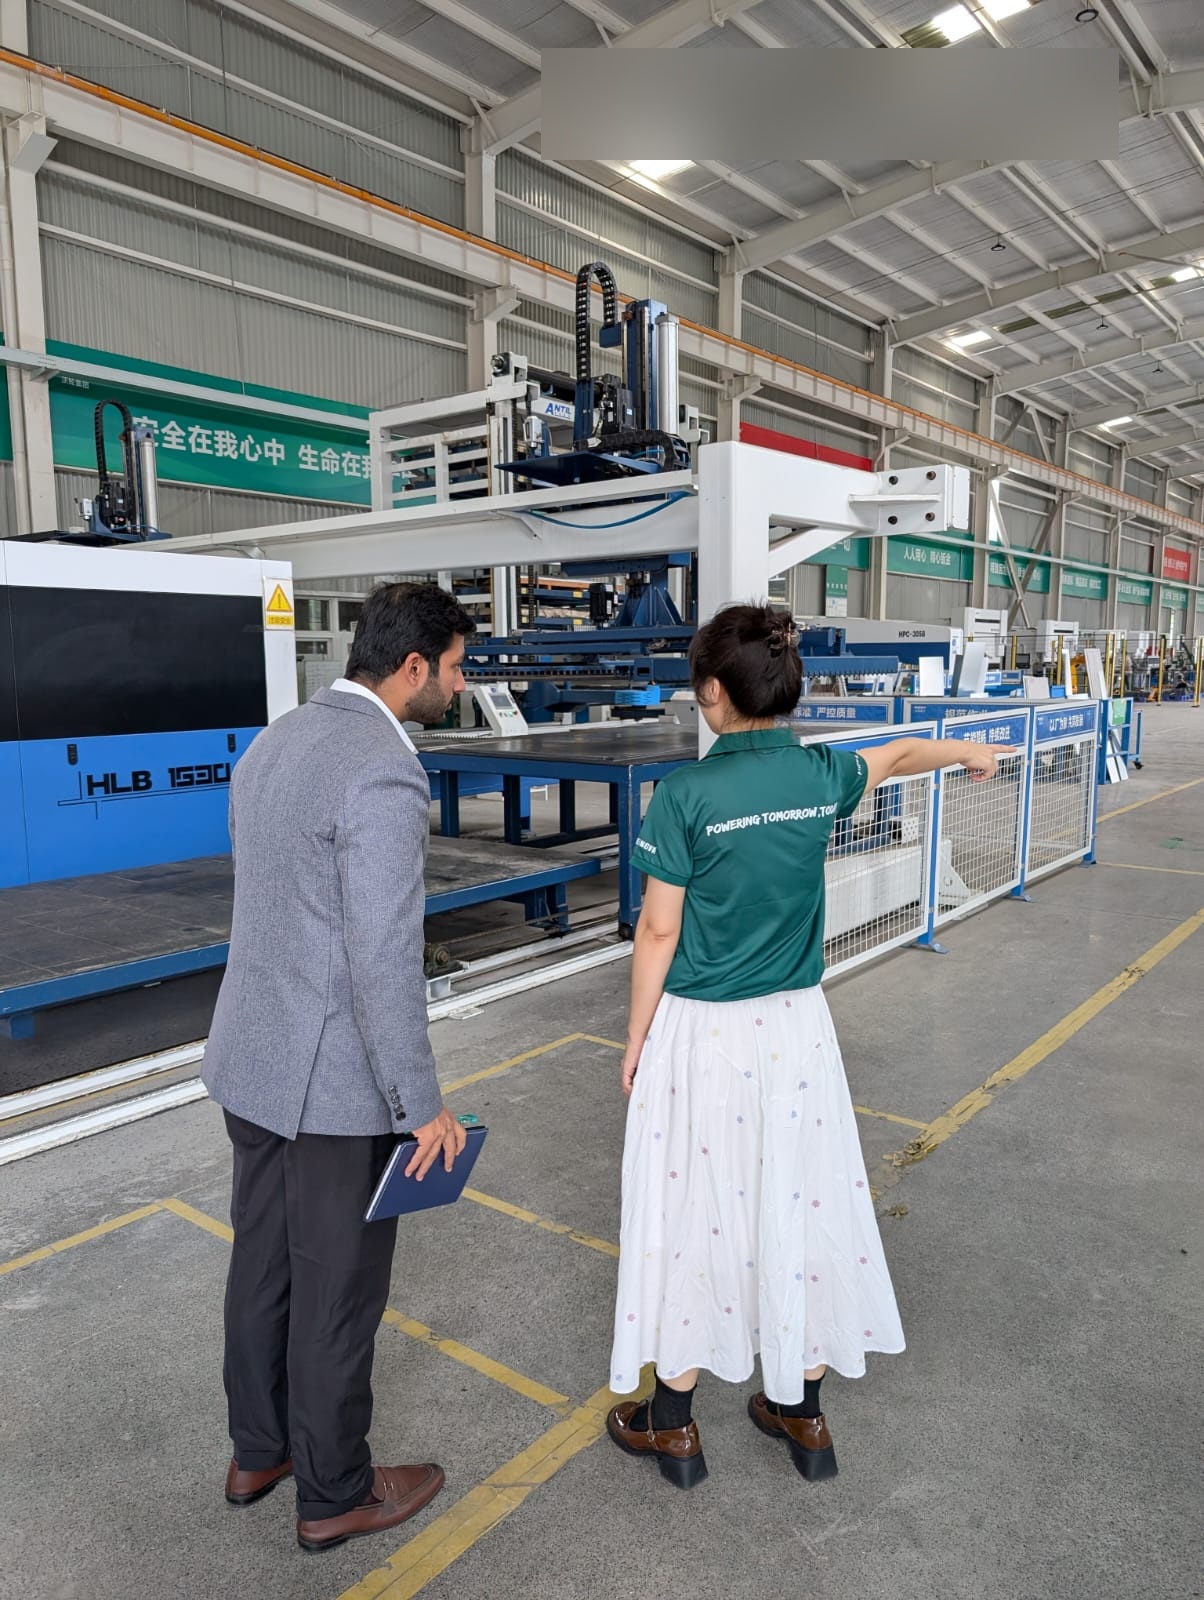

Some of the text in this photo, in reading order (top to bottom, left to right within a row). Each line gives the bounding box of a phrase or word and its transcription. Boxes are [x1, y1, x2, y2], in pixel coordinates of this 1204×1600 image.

[816, 706, 857, 718] 严控质量
[86, 770, 153, 796] HLB
[706, 814, 761, 836] POWERING
